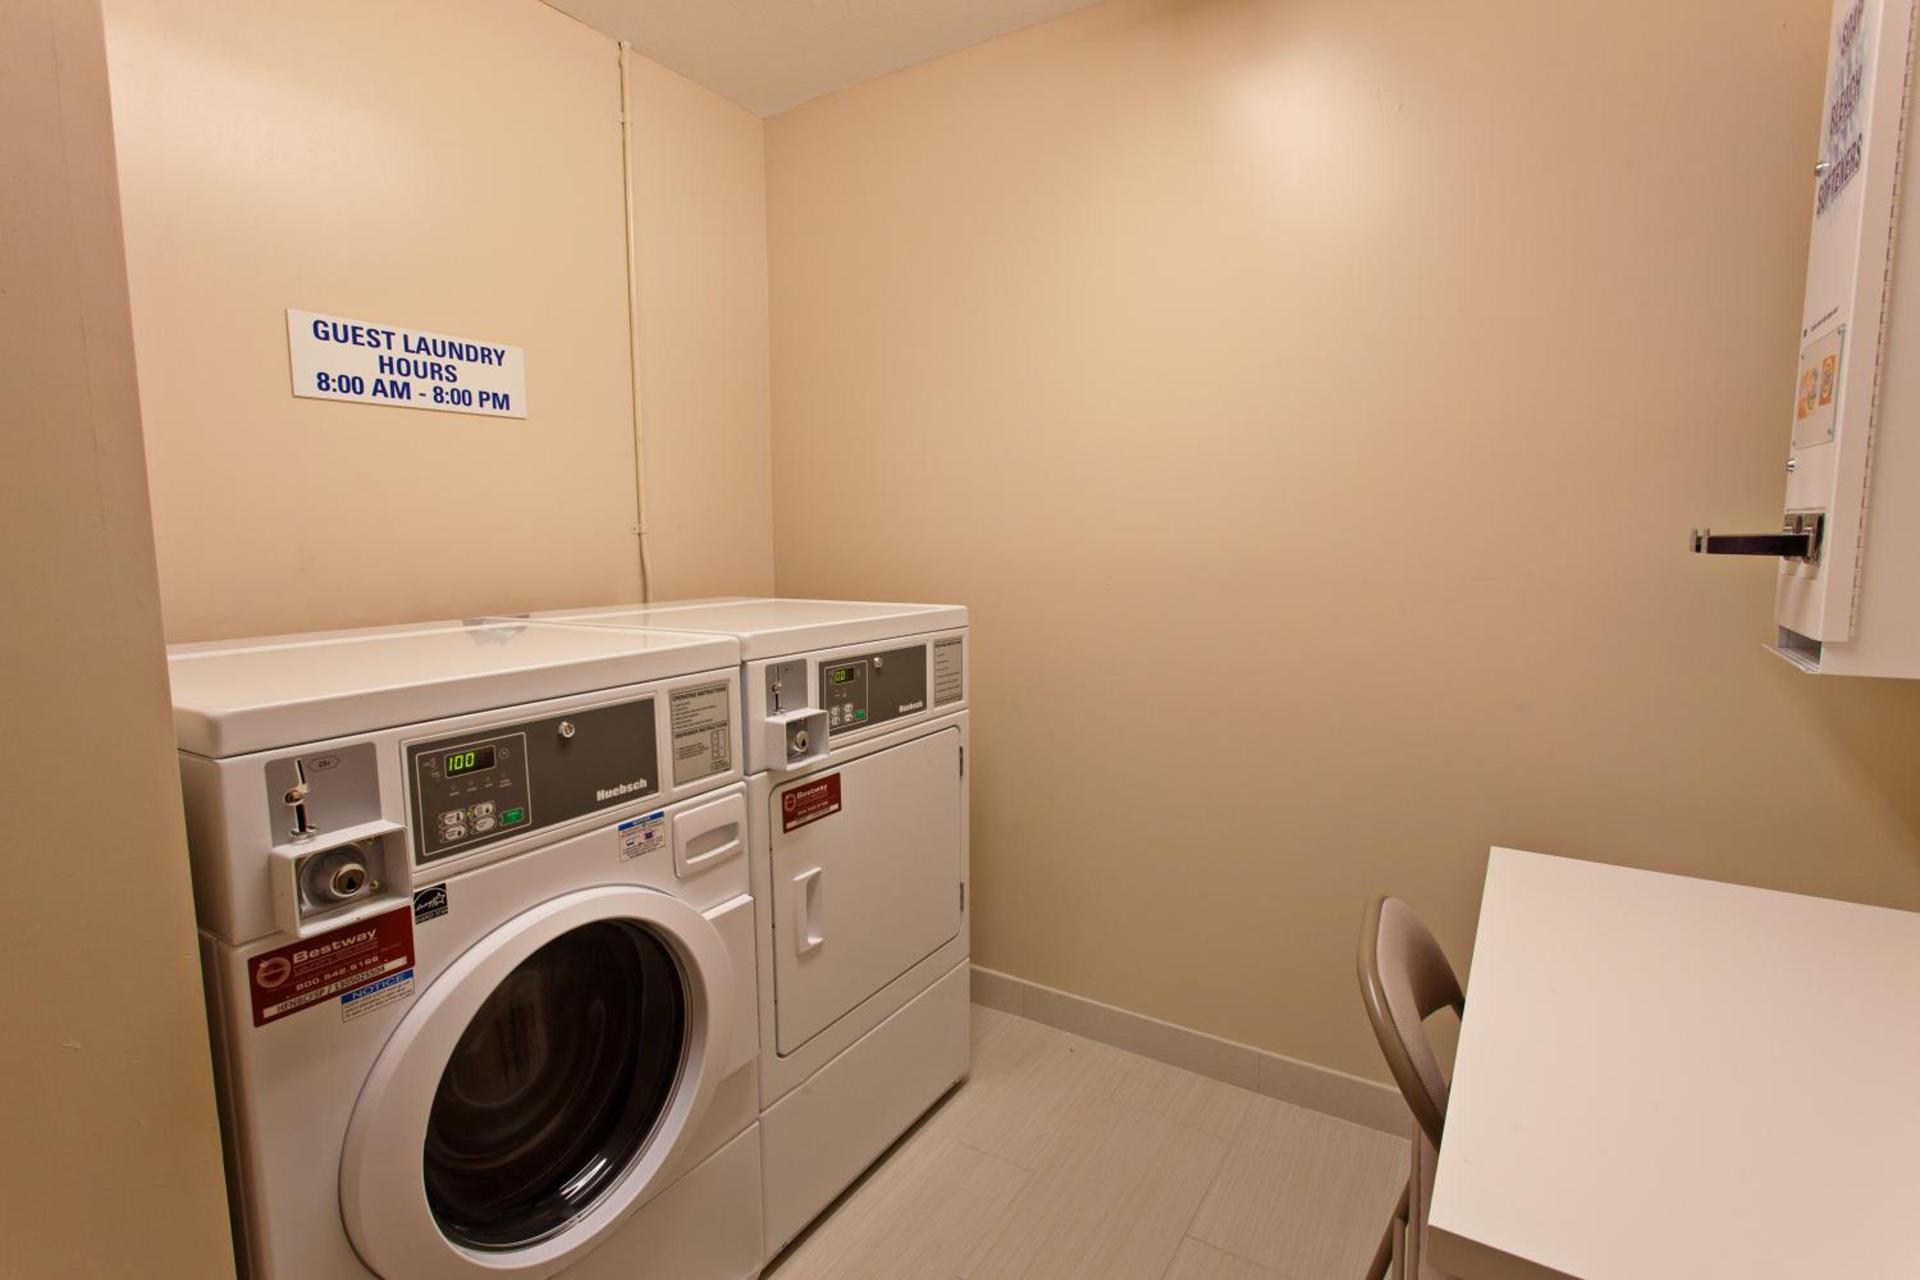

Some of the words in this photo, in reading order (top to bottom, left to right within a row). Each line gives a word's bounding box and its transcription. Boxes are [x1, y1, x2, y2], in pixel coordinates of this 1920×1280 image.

[312, 319, 395, 350] GUEST
[403, 334, 506, 367] LAUNDRY
[378, 354, 458, 383] HOURS
[316, 371, 364, 395] 8:00
[371, 378, 412, 400] AM
[433, 386, 473, 407] 8:00
[478, 390, 511, 411] PM
[448, 752, 475, 771] 100
[596, 778, 648, 801] Huebsch
[292, 928, 377, 965] Bestway
[351, 973, 407, 1000] NOTICE
